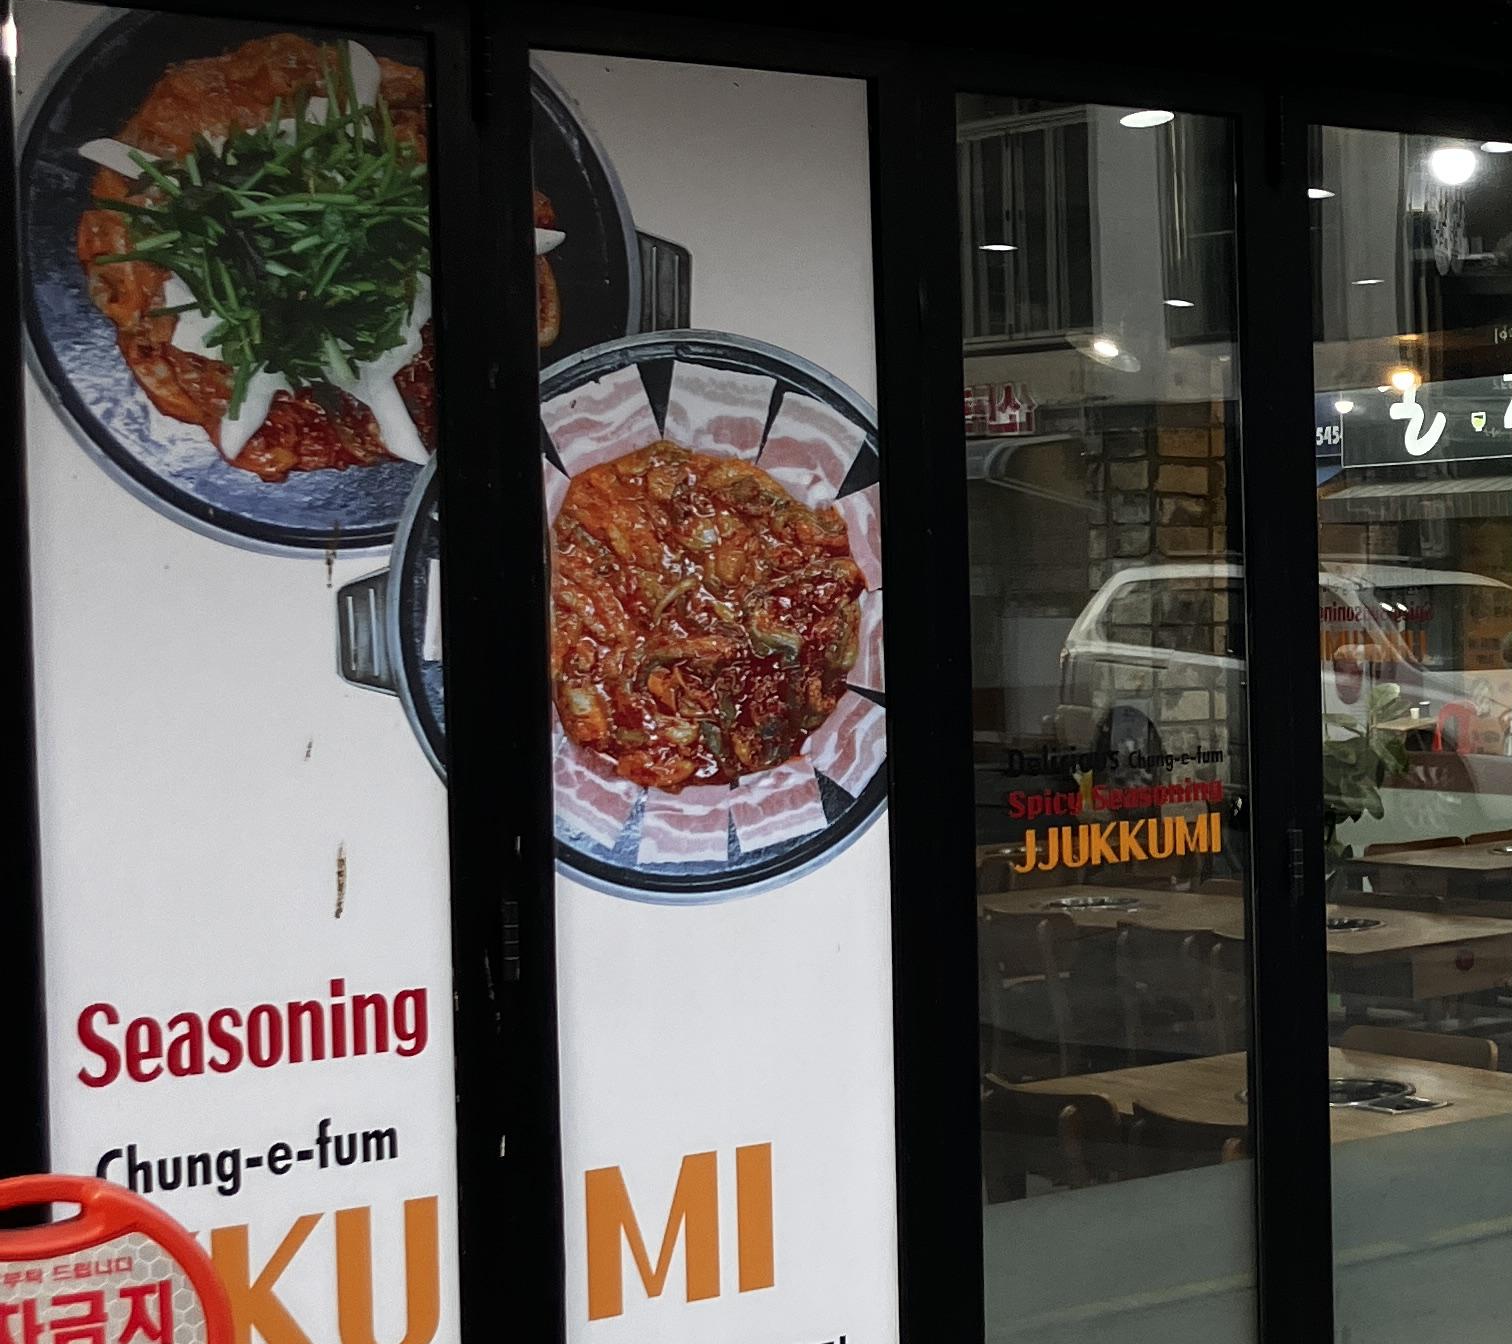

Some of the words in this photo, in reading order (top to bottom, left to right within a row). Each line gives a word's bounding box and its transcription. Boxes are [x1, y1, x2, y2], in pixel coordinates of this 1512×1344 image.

[1007, 788, 1084, 820] Spicy
[1092, 777, 1225, 812] Seasoning
[1013, 812, 1222, 874] JJUKKUMI
[75, 977, 430, 1089] Seasoning
[94, 1118, 399, 1197] Chung-e-fum
[53, 1255, 133, 1281] 드립니다
